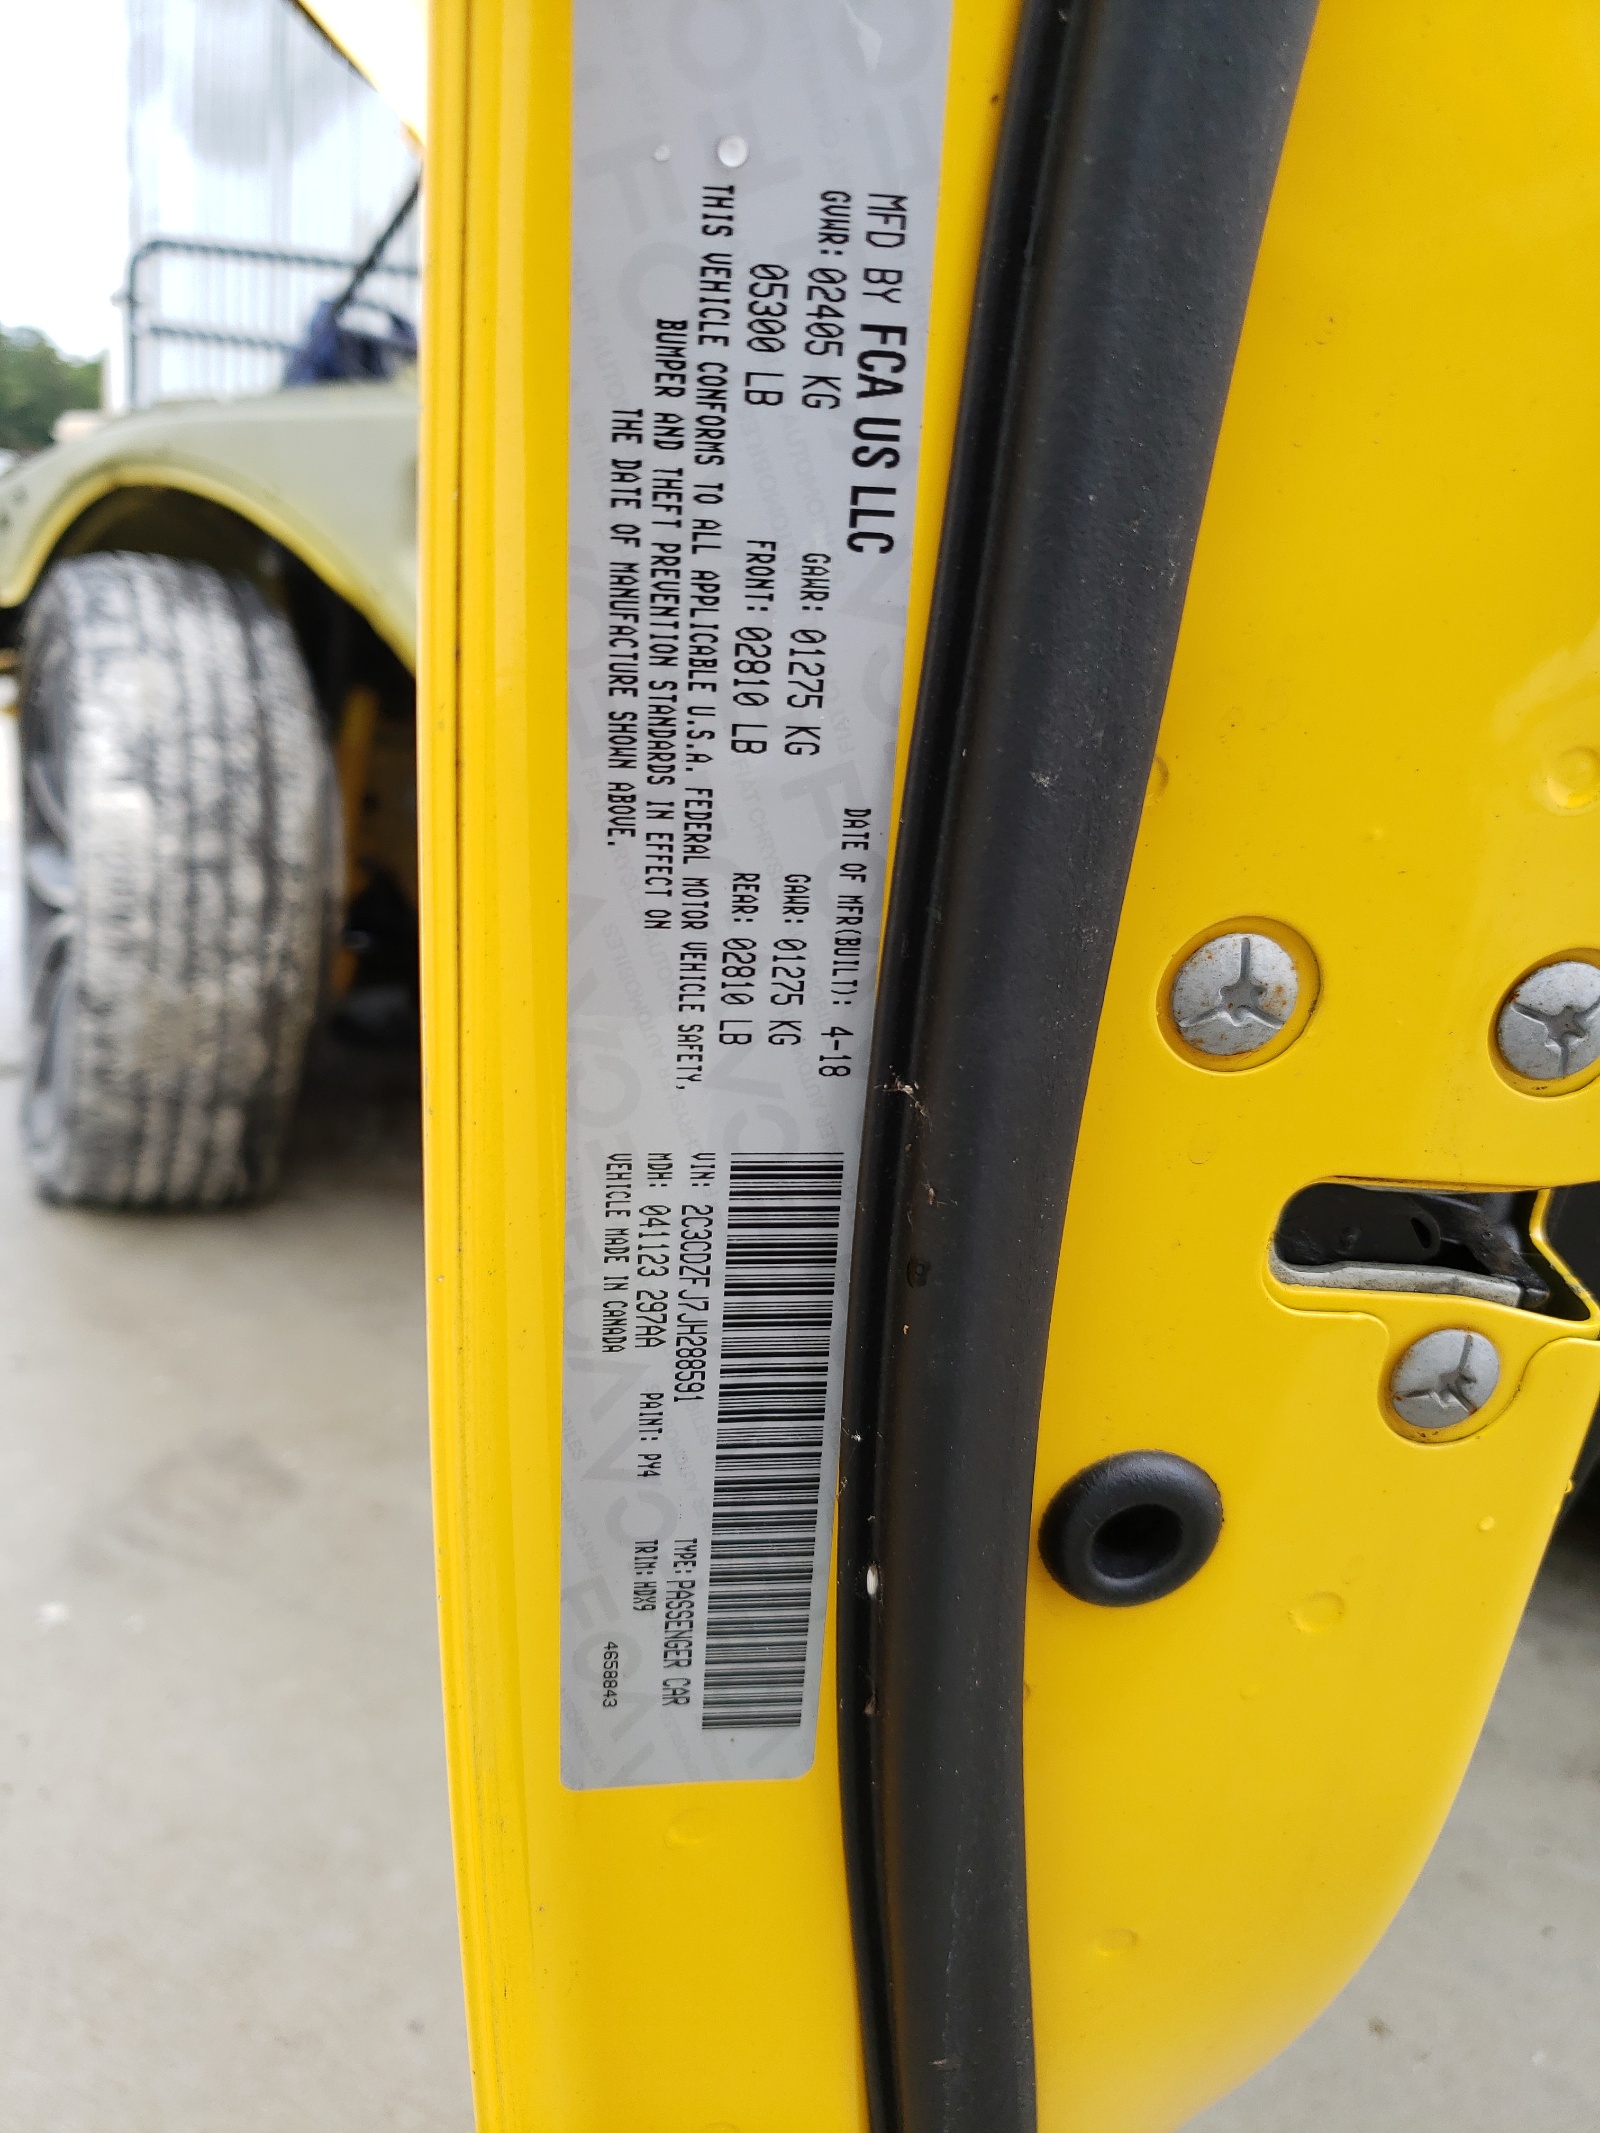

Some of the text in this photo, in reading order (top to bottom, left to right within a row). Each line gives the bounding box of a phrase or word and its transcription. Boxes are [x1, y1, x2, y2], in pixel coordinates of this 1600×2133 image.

[743, 263, 790, 407] 05300 LB
[801, 189, 853, 410] GVWR: 02405 KG
[846, 193, 909, 555] MFD BY FCA US LLC
[606, 408, 644, 846] THE DATE OF MANUFACTURE SHOWN ABOVE.
[643, 318, 689, 930] BUMPER AND THEFT PREVENTION STANDARDS IN EFFECT ON
[675, 184, 736, 1090] THIS VEHICLE CONFORMS TO ALL APPLICABLE U.S.A. FEDERAL MOTOR VEHICLE SAFETY,
[744, 539, 778, 612] FRONT:
[783, 552, 832, 756] GAWR: 01275 KG
[730, 723, 769, 755] LB
[732, 626, 773, 707] 02810
[720, 937, 758, 1006] 02810
[730, 872, 761, 923] REAR:
[767, 873, 812, 1046] GAWR: 01275 KG
[818, 807, 872, 1077] DATE OF MFR(BUILT): 4-18
[718, 1019, 754, 1046] LB
[601, 1153, 633, 1353] VEHICLE MADE IN CANADA
[634, 1152, 674, 1348] MDH: 041123 297AA
[673, 1152, 717, 1403] VIN: 2C3CDZFJ7JH288591
[636, 1392, 665, 1478] PAINT: PY4
[632, 1538, 659, 1612] TRIM: HDX9
[661, 1537, 698, 1706] TYPE: PASSENGER CAR
[602, 1641, 619, 1708] 4658843
